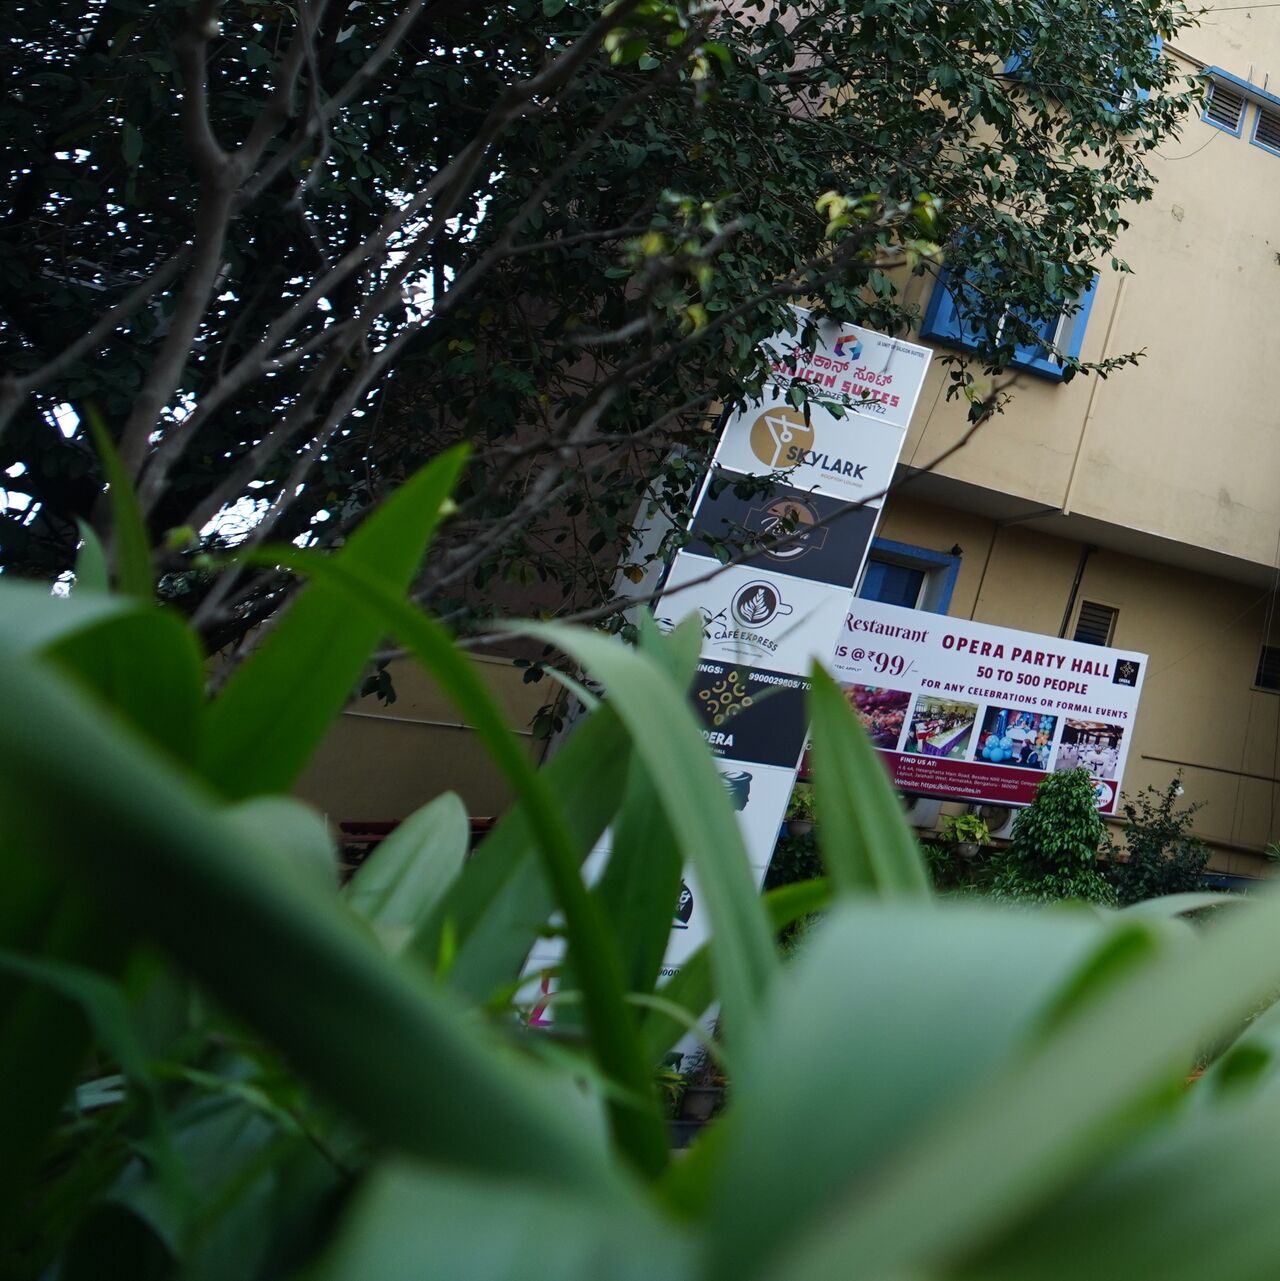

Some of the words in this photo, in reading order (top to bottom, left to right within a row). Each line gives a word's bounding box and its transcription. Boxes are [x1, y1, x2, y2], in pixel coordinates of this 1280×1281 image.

[841, 382, 901, 407] SUTES
[786, 445, 867, 480] SKYLARK
[740, 631, 778, 652] EXPRESS
[845, 612, 929, 642] Restaurant
[941, 634, 1004, 659] OPERA
[1011, 647, 1066, 670] PARTY
[1070, 658, 1110, 678] HALL
[976, 666, 993, 679] 50
[997, 669, 1013, 682] TO
[1016, 673, 1041, 687] 500
[1043, 677, 1088, 696] PEOPLE
[921, 678, 940, 690] FOR
[944, 682, 965, 693] ANY
[967, 686, 1037, 705] CELEBRATIONS
[1040, 698, 1053, 707] OR
[1056, 700, 1092, 714] FORMAL
[1095, 707, 1128, 719] EVENTS
[900, 756, 916, 764] FIND
[895, 778, 919, 787] Website:
